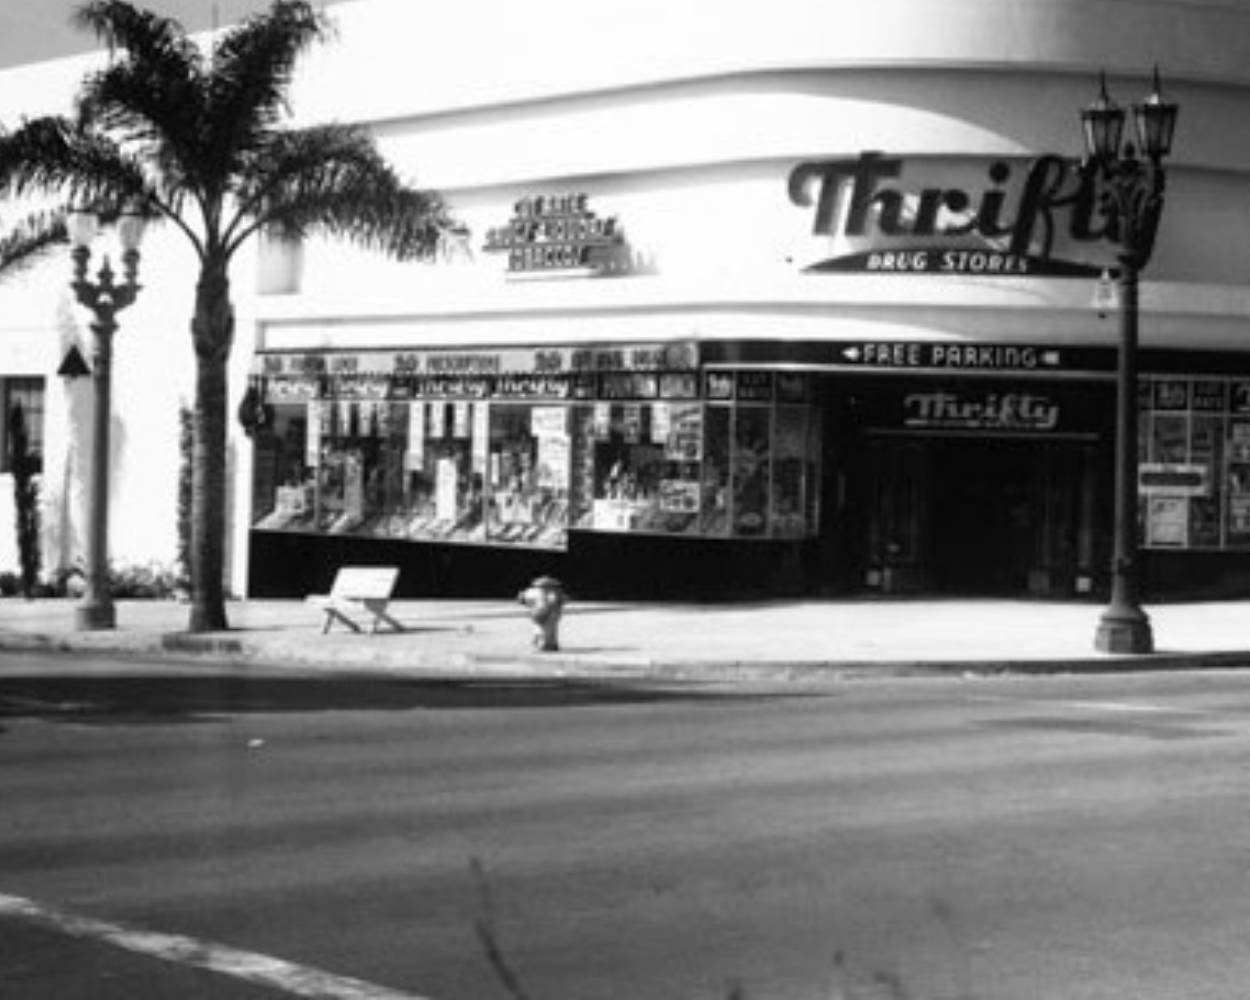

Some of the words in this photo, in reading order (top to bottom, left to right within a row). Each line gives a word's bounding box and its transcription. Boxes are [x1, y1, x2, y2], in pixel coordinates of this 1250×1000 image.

[867, 251, 928, 270] DRUG
[944, 251, 1029, 272] STORES
[864, 343, 921, 365] FREE
[932, 347, 1037, 368] PARKING
[904, 393, 1059, 428] Thrifty
